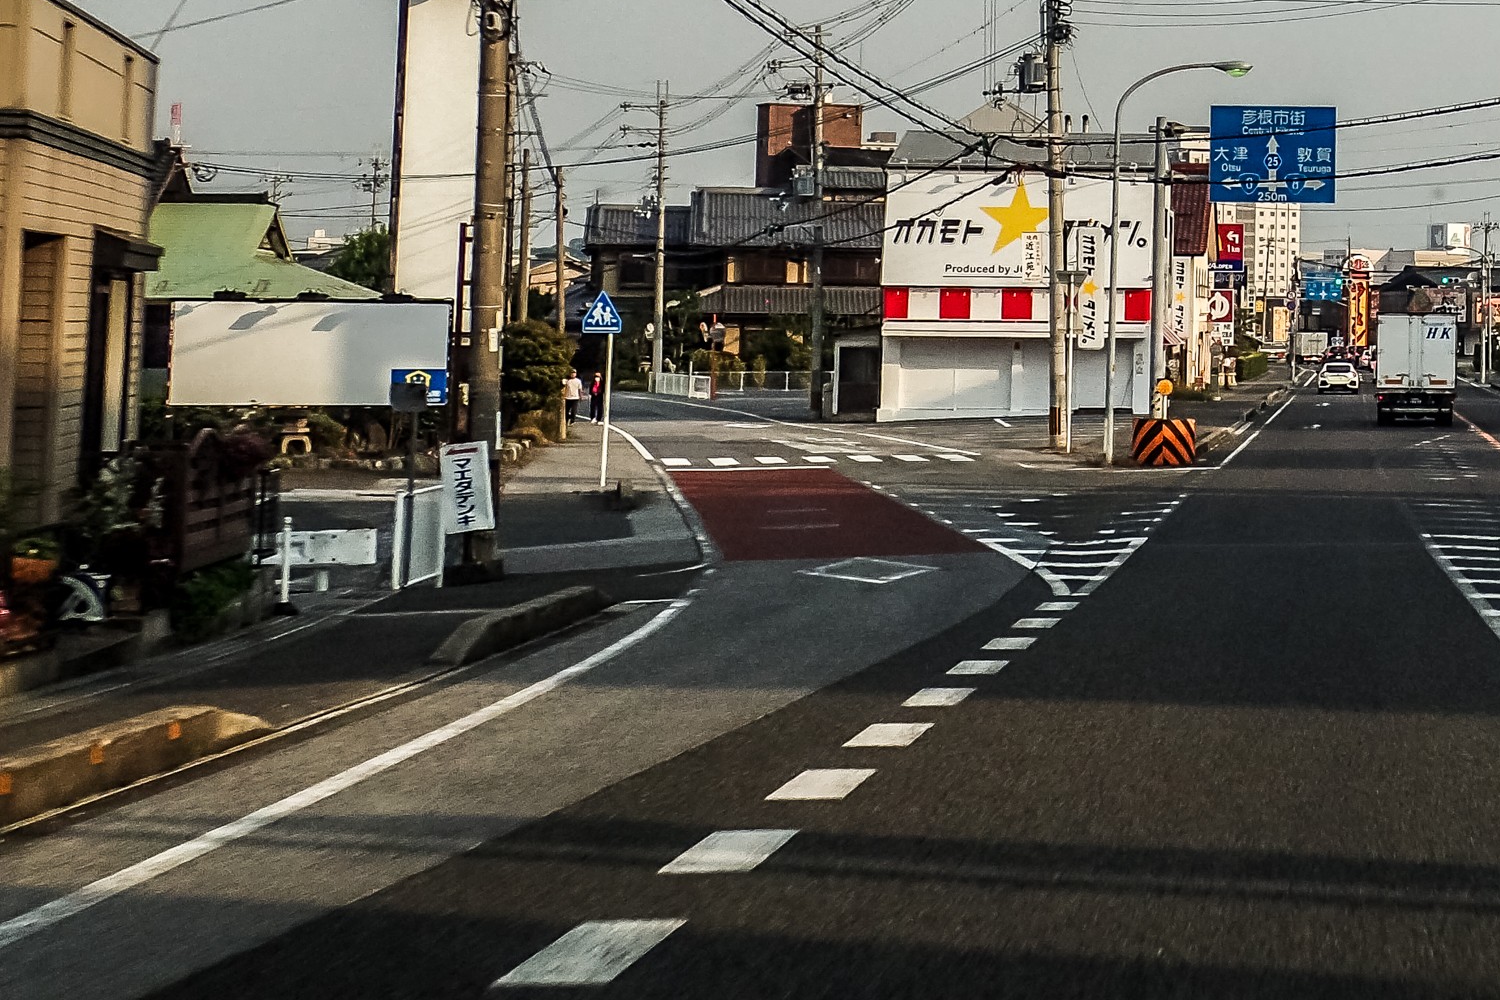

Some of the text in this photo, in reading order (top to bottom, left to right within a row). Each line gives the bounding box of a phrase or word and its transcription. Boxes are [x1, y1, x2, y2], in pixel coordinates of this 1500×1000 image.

[1242, 110, 1306, 125] 彦根市街
[1214, 147, 1248, 161] 大津
[1297, 147, 1332, 163] 敦賀
[1267, 157, 1279, 166] 25
[1221, 163, 1241, 172] Otsu
[1297, 164, 1332, 174] Tsuruga
[1258, 192, 1287, 201] 250m
[893, 218, 984, 244] オカモト
[945, 264, 995, 274] Produced
[998, 264, 1011, 275] by
